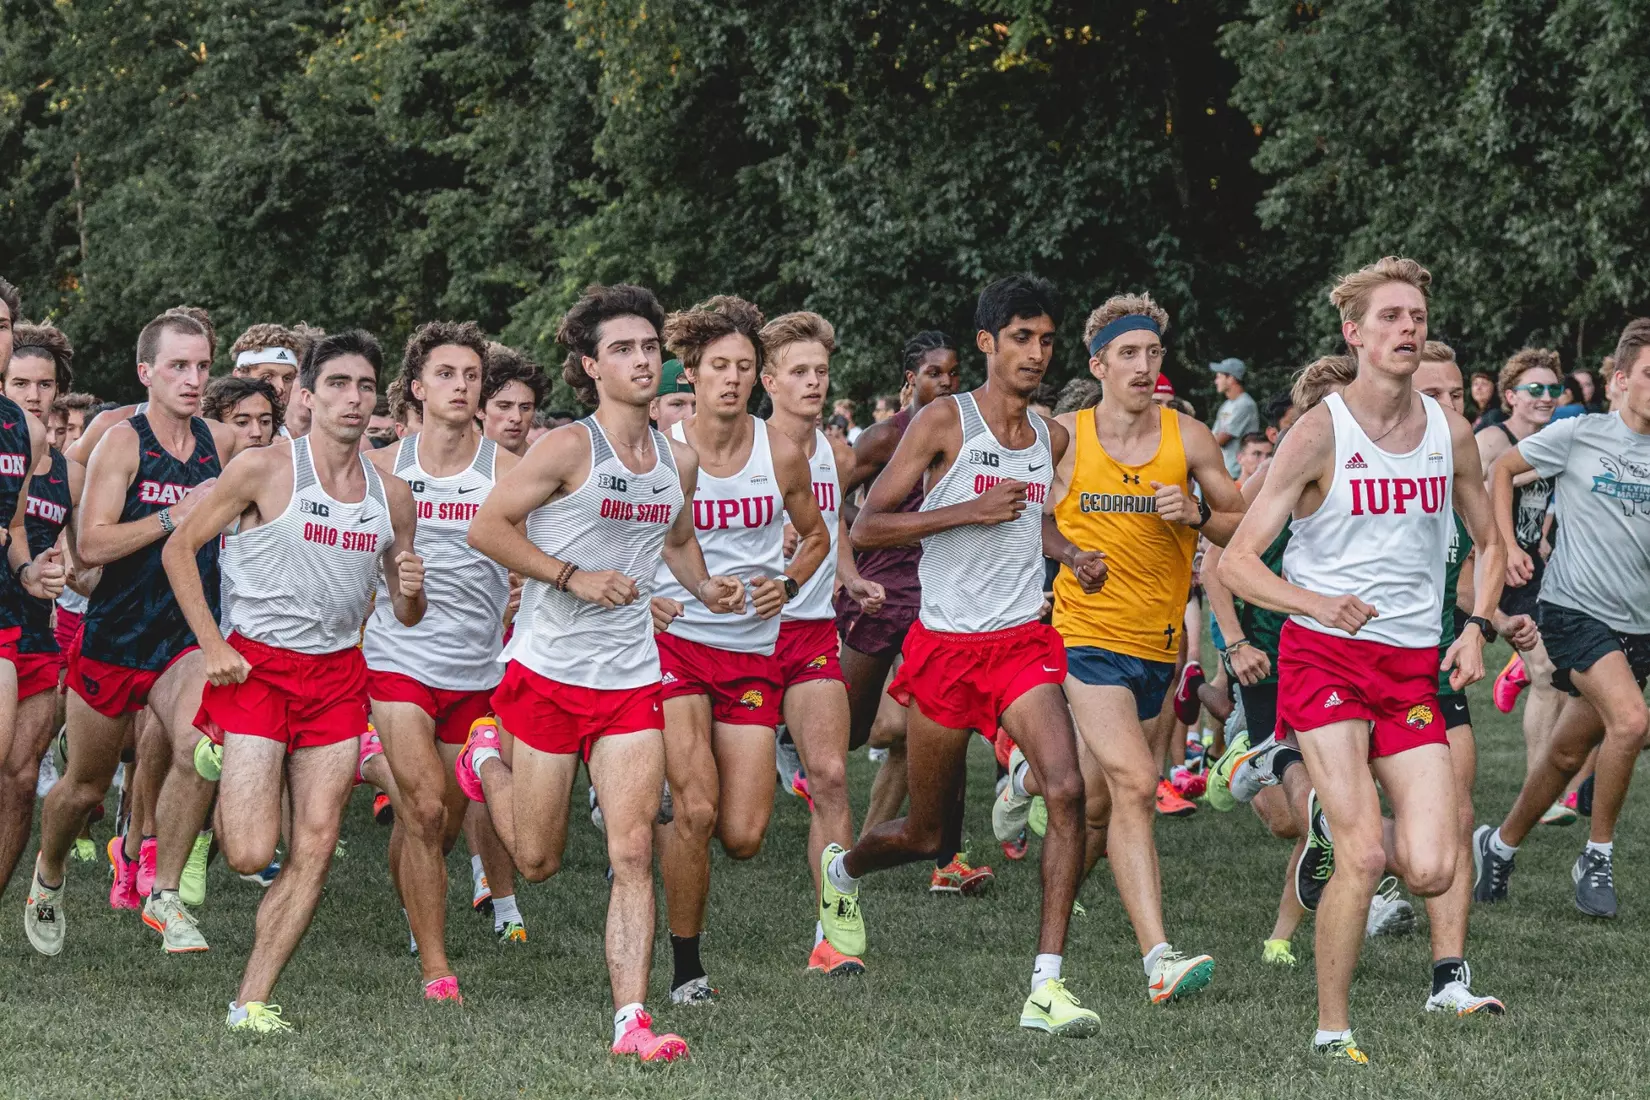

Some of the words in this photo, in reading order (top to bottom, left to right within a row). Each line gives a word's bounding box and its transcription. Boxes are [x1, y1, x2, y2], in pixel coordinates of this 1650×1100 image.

[416, 501, 433, 519] IO
[1349, 476, 1446, 516] IUPUI
[600, 498, 633, 521] OHIO
[637, 504, 672, 524] STATE
[303, 522, 338, 547] OHIO
[342, 531, 378, 552] STATE
